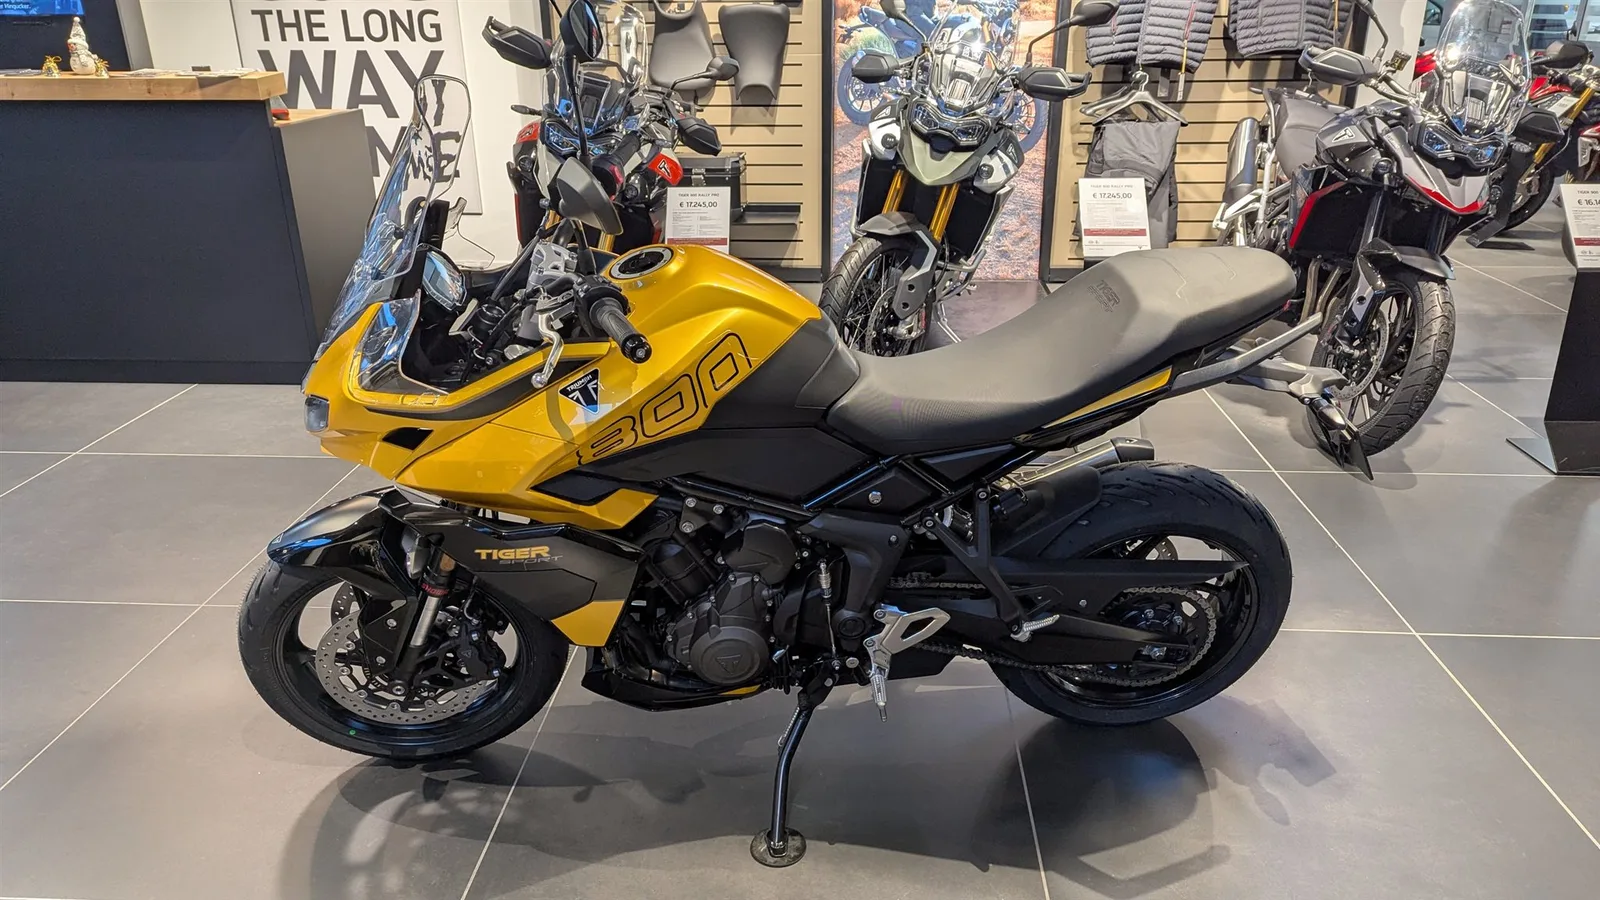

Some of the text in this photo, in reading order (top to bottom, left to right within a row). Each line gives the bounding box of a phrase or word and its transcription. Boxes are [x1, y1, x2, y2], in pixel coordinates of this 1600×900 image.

[251, 8, 442, 43] THE LONG
[258, 49, 444, 125] WAY
[566, 374, 592, 392] TRIUMPH
[576, 332, 753, 466] 800
[474, 545, 551, 560] TIGER
[499, 555, 564, 565] SPORT
